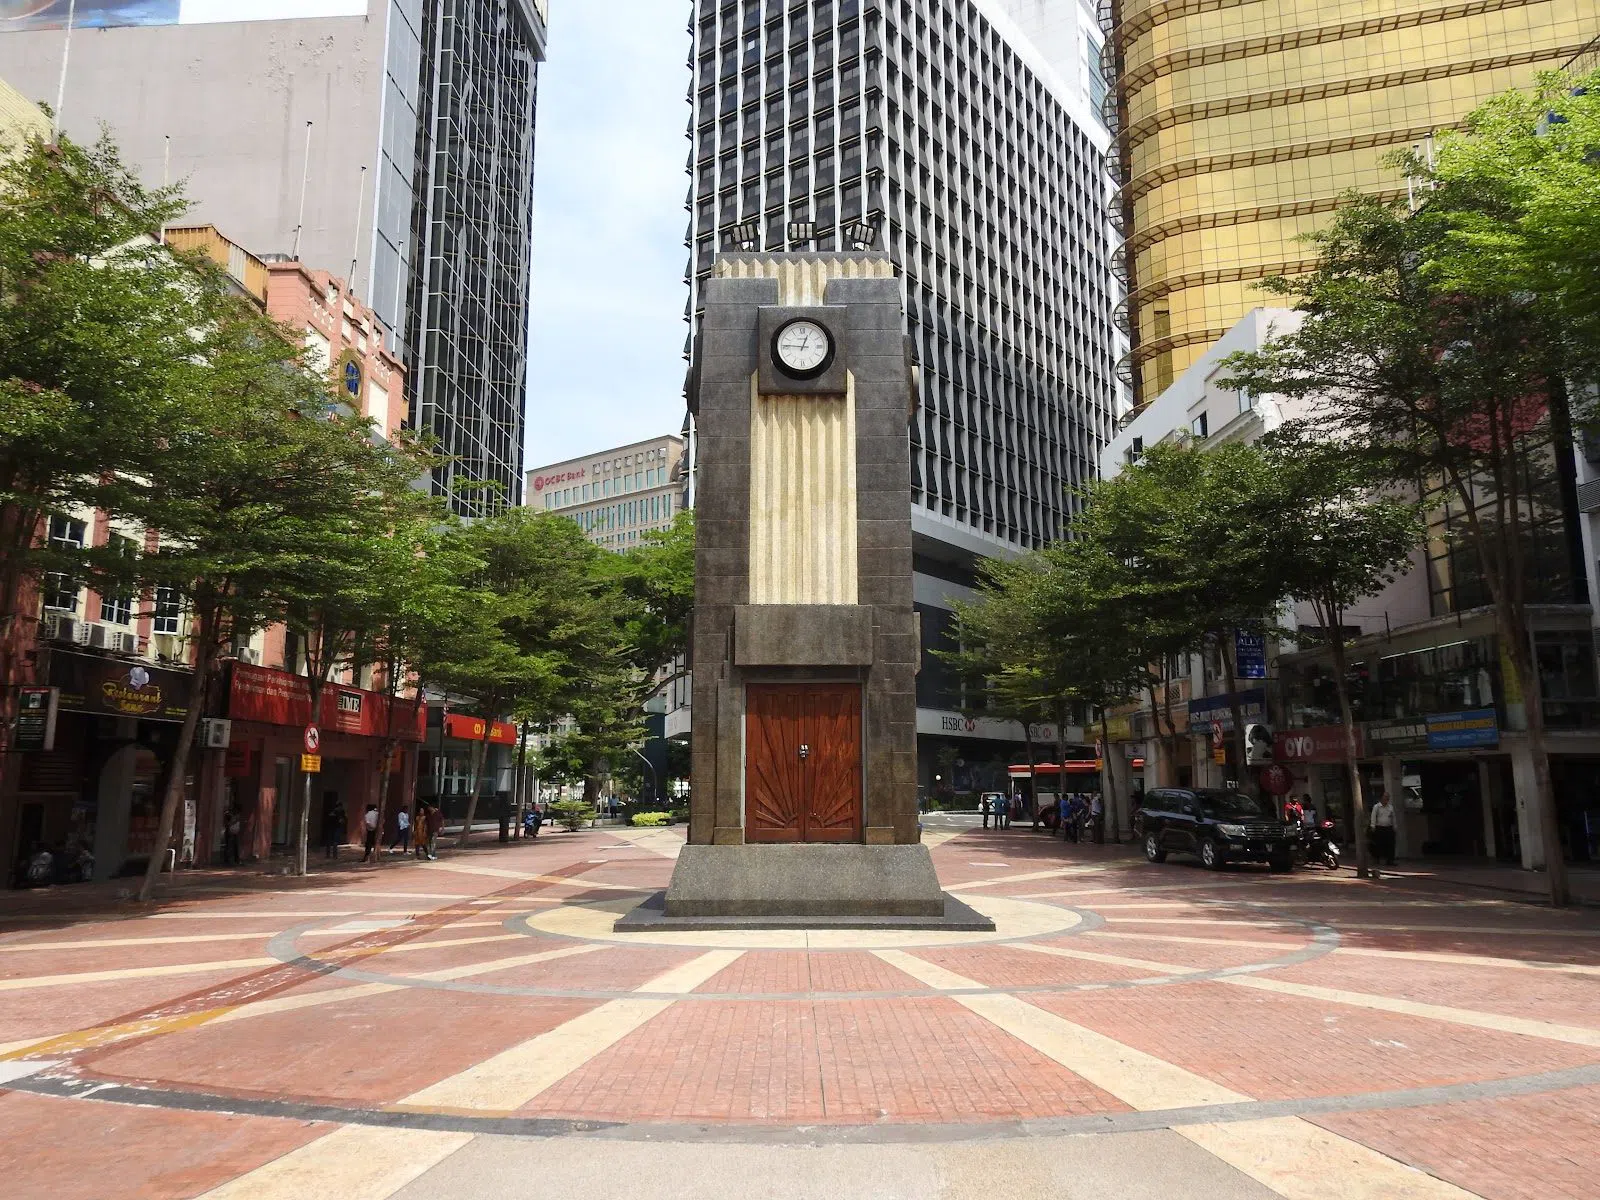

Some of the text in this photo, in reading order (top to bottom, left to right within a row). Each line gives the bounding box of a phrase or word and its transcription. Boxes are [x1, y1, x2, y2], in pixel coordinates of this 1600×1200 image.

[545, 469, 585, 485] OCBC Bank
[1238, 636, 1262, 646] ALLY
[102, 681, 162, 703] Restaurant
[342, 695, 360, 712] IME
[942, 716, 964, 732] HSBC
[1284, 735, 1314, 757] OYO
